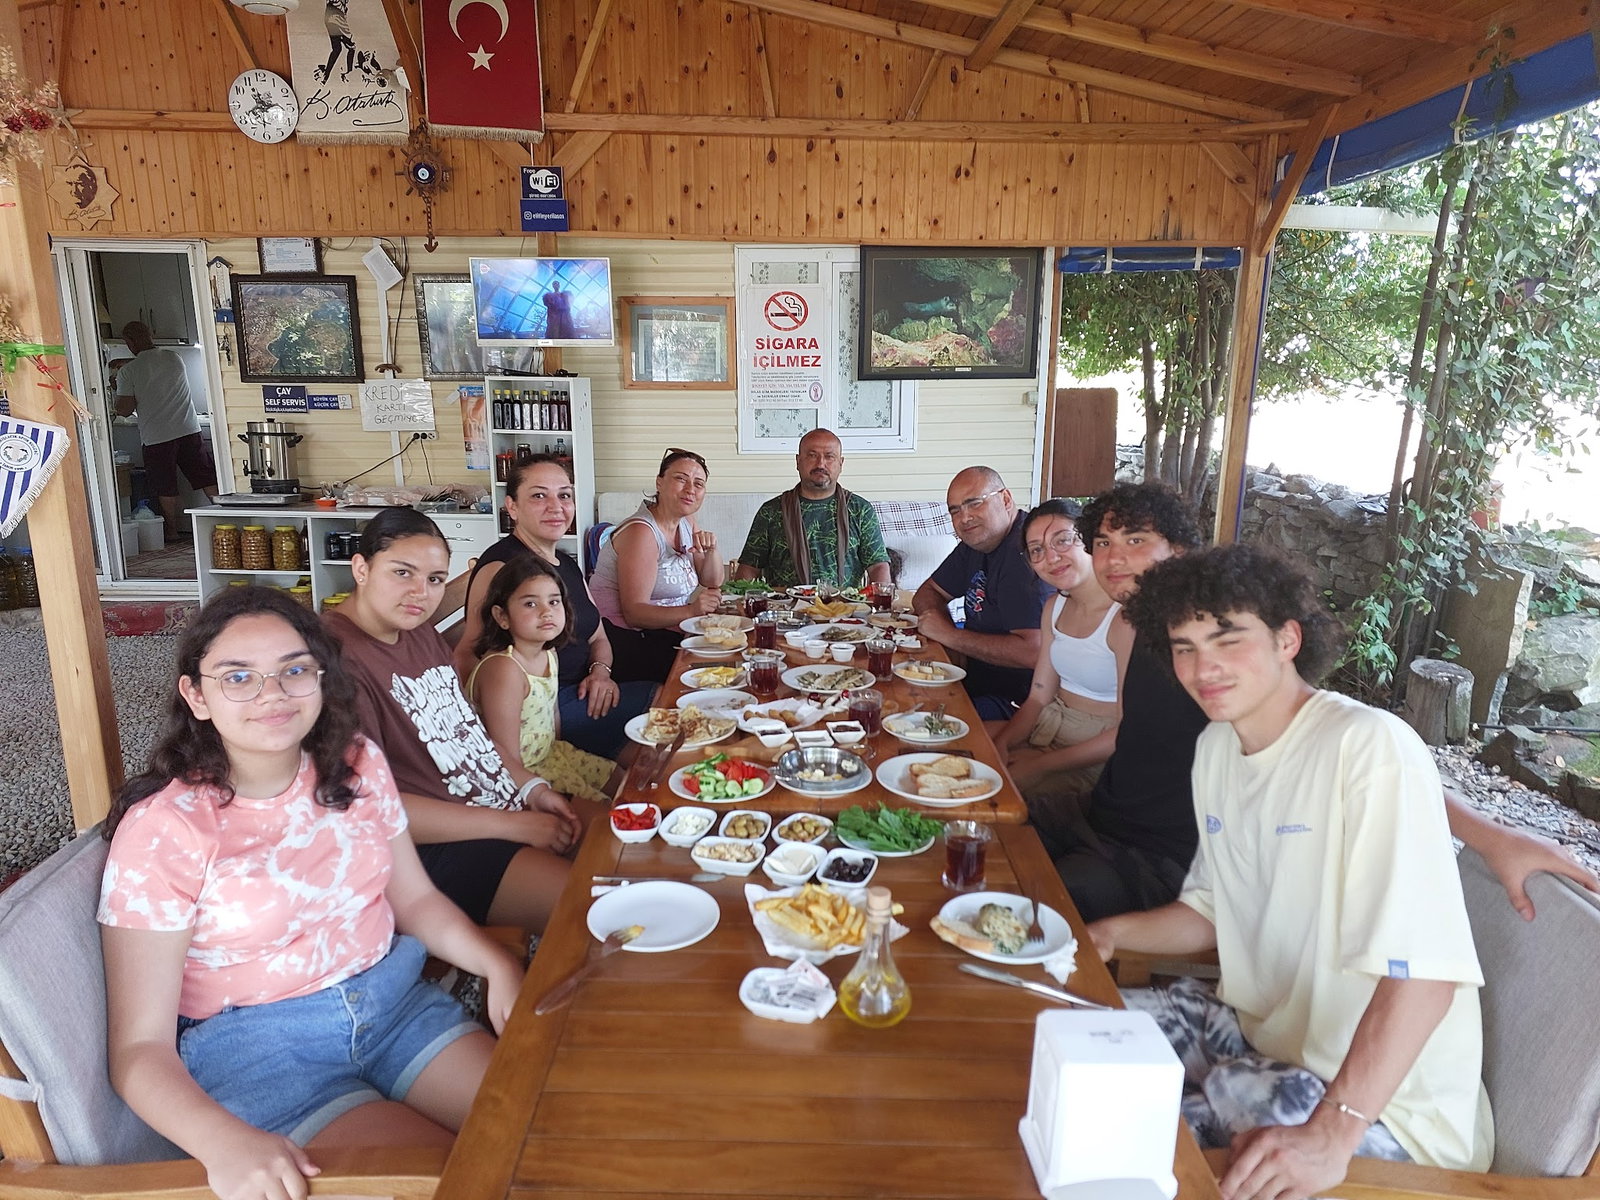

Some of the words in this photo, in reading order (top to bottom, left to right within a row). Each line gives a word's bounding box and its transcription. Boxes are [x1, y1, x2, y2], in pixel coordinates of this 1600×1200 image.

[244, 77, 251, 86] 11
[255, 72, 266, 82] 12
[235, 86, 245, 95] 10
[281, 87, 289, 98] 2
[286, 103, 295, 113] 3
[240, 115, 248, 125] 8
[251, 126, 257, 136] 7
[263, 131, 271, 140] 6
[276, 127, 284, 137] 5
[755, 335, 819, 350] SİGARA
[753, 353, 821, 370] İÇİLMEZ
[276, 387, 292, 397] ÇAY
[265, 398, 280, 406] SELF
[281, 397, 306, 406] SERVİS
